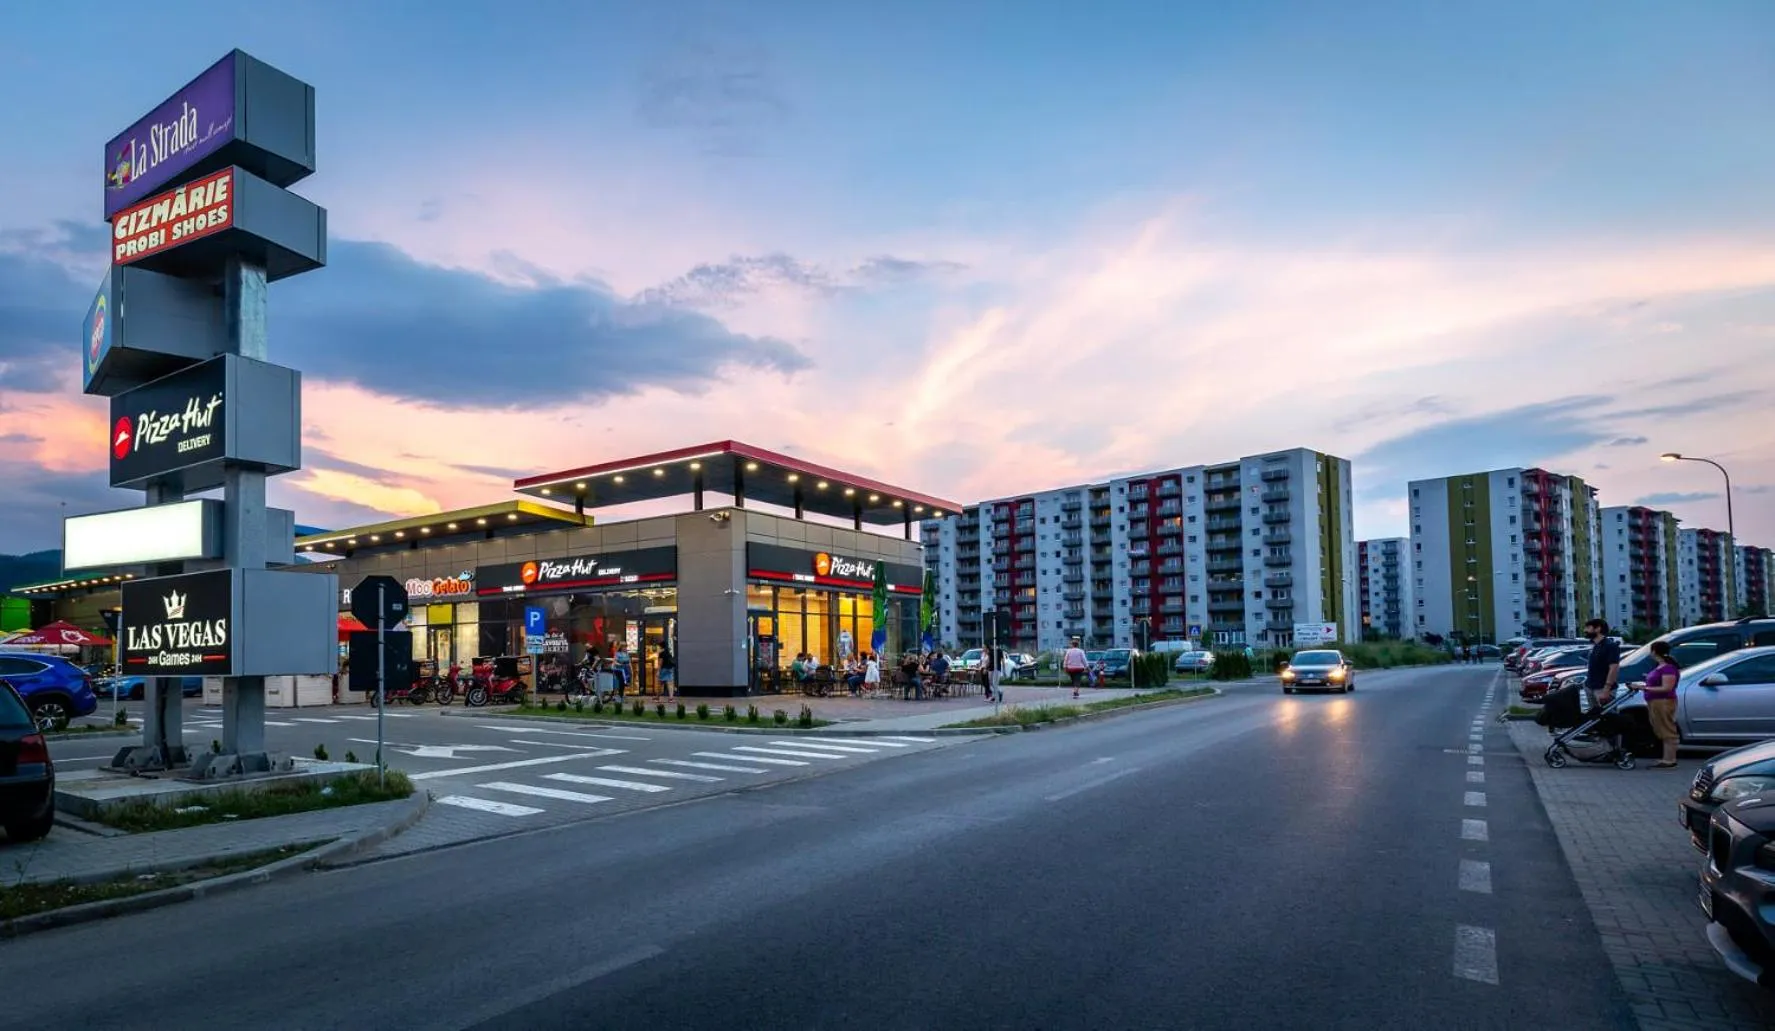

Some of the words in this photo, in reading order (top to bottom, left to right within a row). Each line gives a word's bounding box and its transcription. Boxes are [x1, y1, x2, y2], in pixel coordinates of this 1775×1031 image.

[130, 139, 147, 182] La
[150, 101, 198, 168] Strada
[115, 228, 166, 261] PROBI
[172, 204, 228, 240] SHOES
[134, 410, 181, 452] Pizza
[181, 394, 223, 434] Hut
[177, 433, 212, 453] DELIVERY
[538, 561, 571, 581] Pizza
[571, 558, 598, 576] Hut
[830, 556, 856, 576] Pizza
[856, 560, 875, 577] Hut
[530, 611, 541, 628] P
[127, 624, 162, 651] LAS
[164, 618, 227, 649] VEGAS
[159, 650, 190, 666] Games
